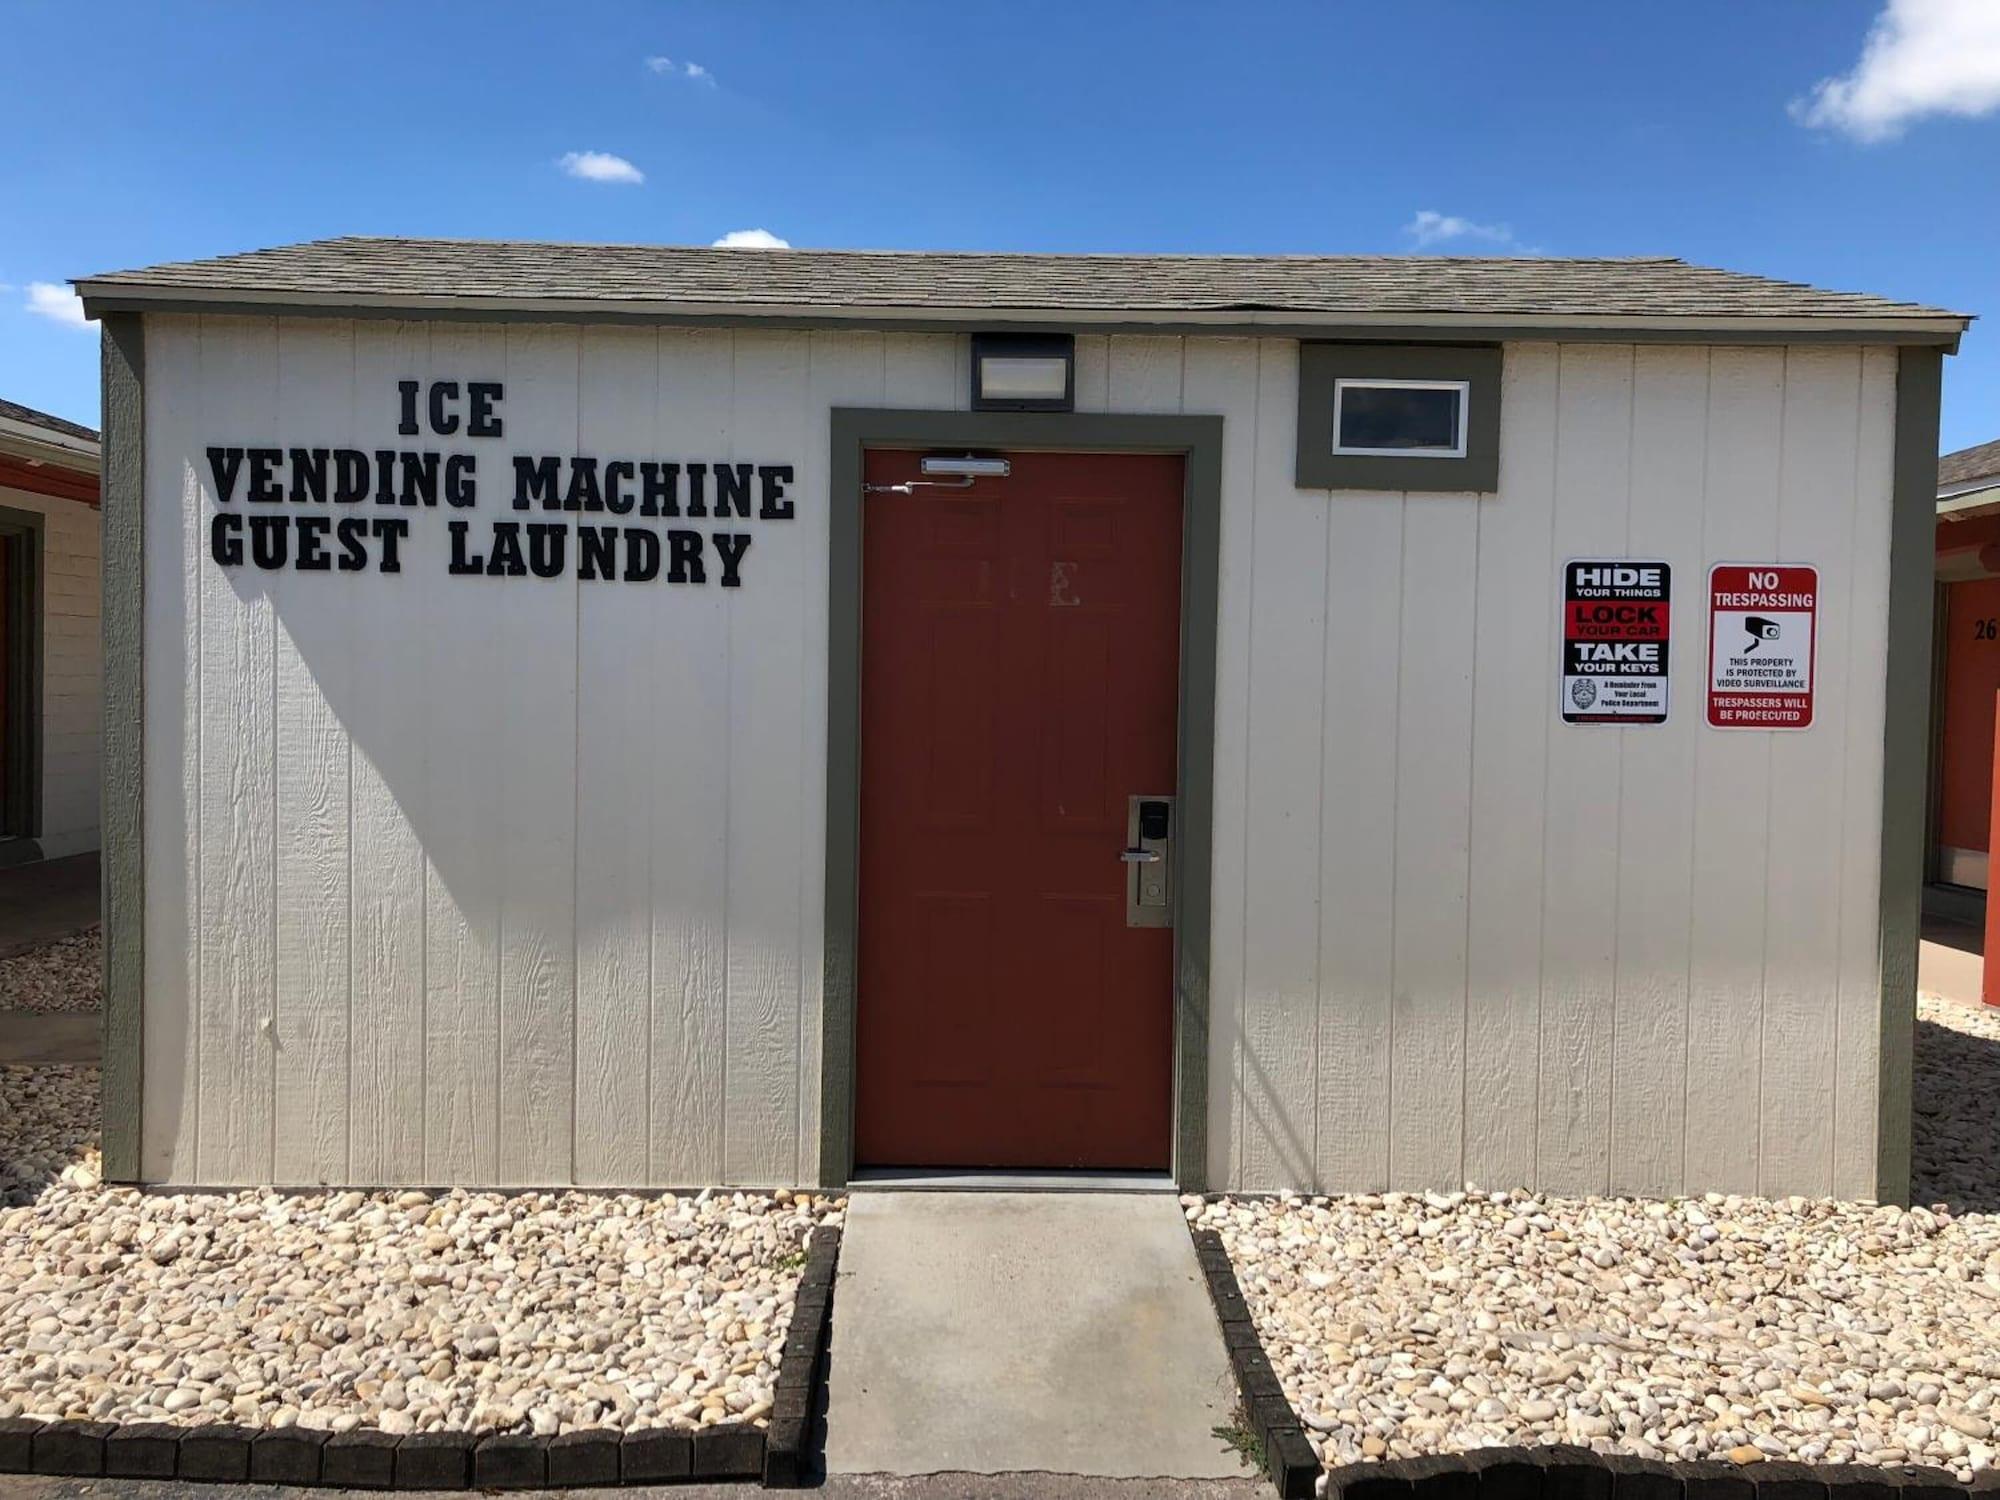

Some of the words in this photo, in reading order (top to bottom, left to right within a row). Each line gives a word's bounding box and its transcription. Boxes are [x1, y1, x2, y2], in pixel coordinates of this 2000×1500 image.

[398, 381, 503, 438] ICE
[206, 447, 477, 509] VENDING
[512, 456, 794, 520] MACHINE
[211, 513, 408, 573] GUEST
[448, 521, 751, 587] LAUNDRY
[1576, 568, 1661, 587] HIDE
[1748, 572, 1779, 590] NO
[1576, 588, 1610, 597] YOUR
[1615, 588, 1661, 598] THINGS
[1714, 593, 1813, 608] TRESPASSING
[1575, 606, 1657, 625] LOCK
[1576, 625, 1620, 635] YOUR
[1626, 625, 1661, 636] CAR
[1974, 619, 1997, 640] 26
[1574, 643, 1659, 661] TAKE
[1574, 663, 1616, 673] YOUR
[1620, 663, 1659, 673] KEYS
[1729, 658, 1748, 666] THIS
[1750, 658, 1794, 667] PROPERTY
[1726, 669, 1734, 677] IS
[1736, 669, 1784, 678] PROTECTED
[1785, 669, 1797, 678] BY
[1717, 679, 1742, 688] VIDEO
[1743, 679, 1806, 689] SURVEILLANCE
[1614, 690, 1628, 698] Your
[1601, 699, 1620, 707] Police
[1713, 697, 1782, 708] TRESPASSERS
[1783, 698, 1808, 709] WILL
[1719, 710, 1734, 720] BE
[1735, 710, 1800, 721] PROSECUTED
